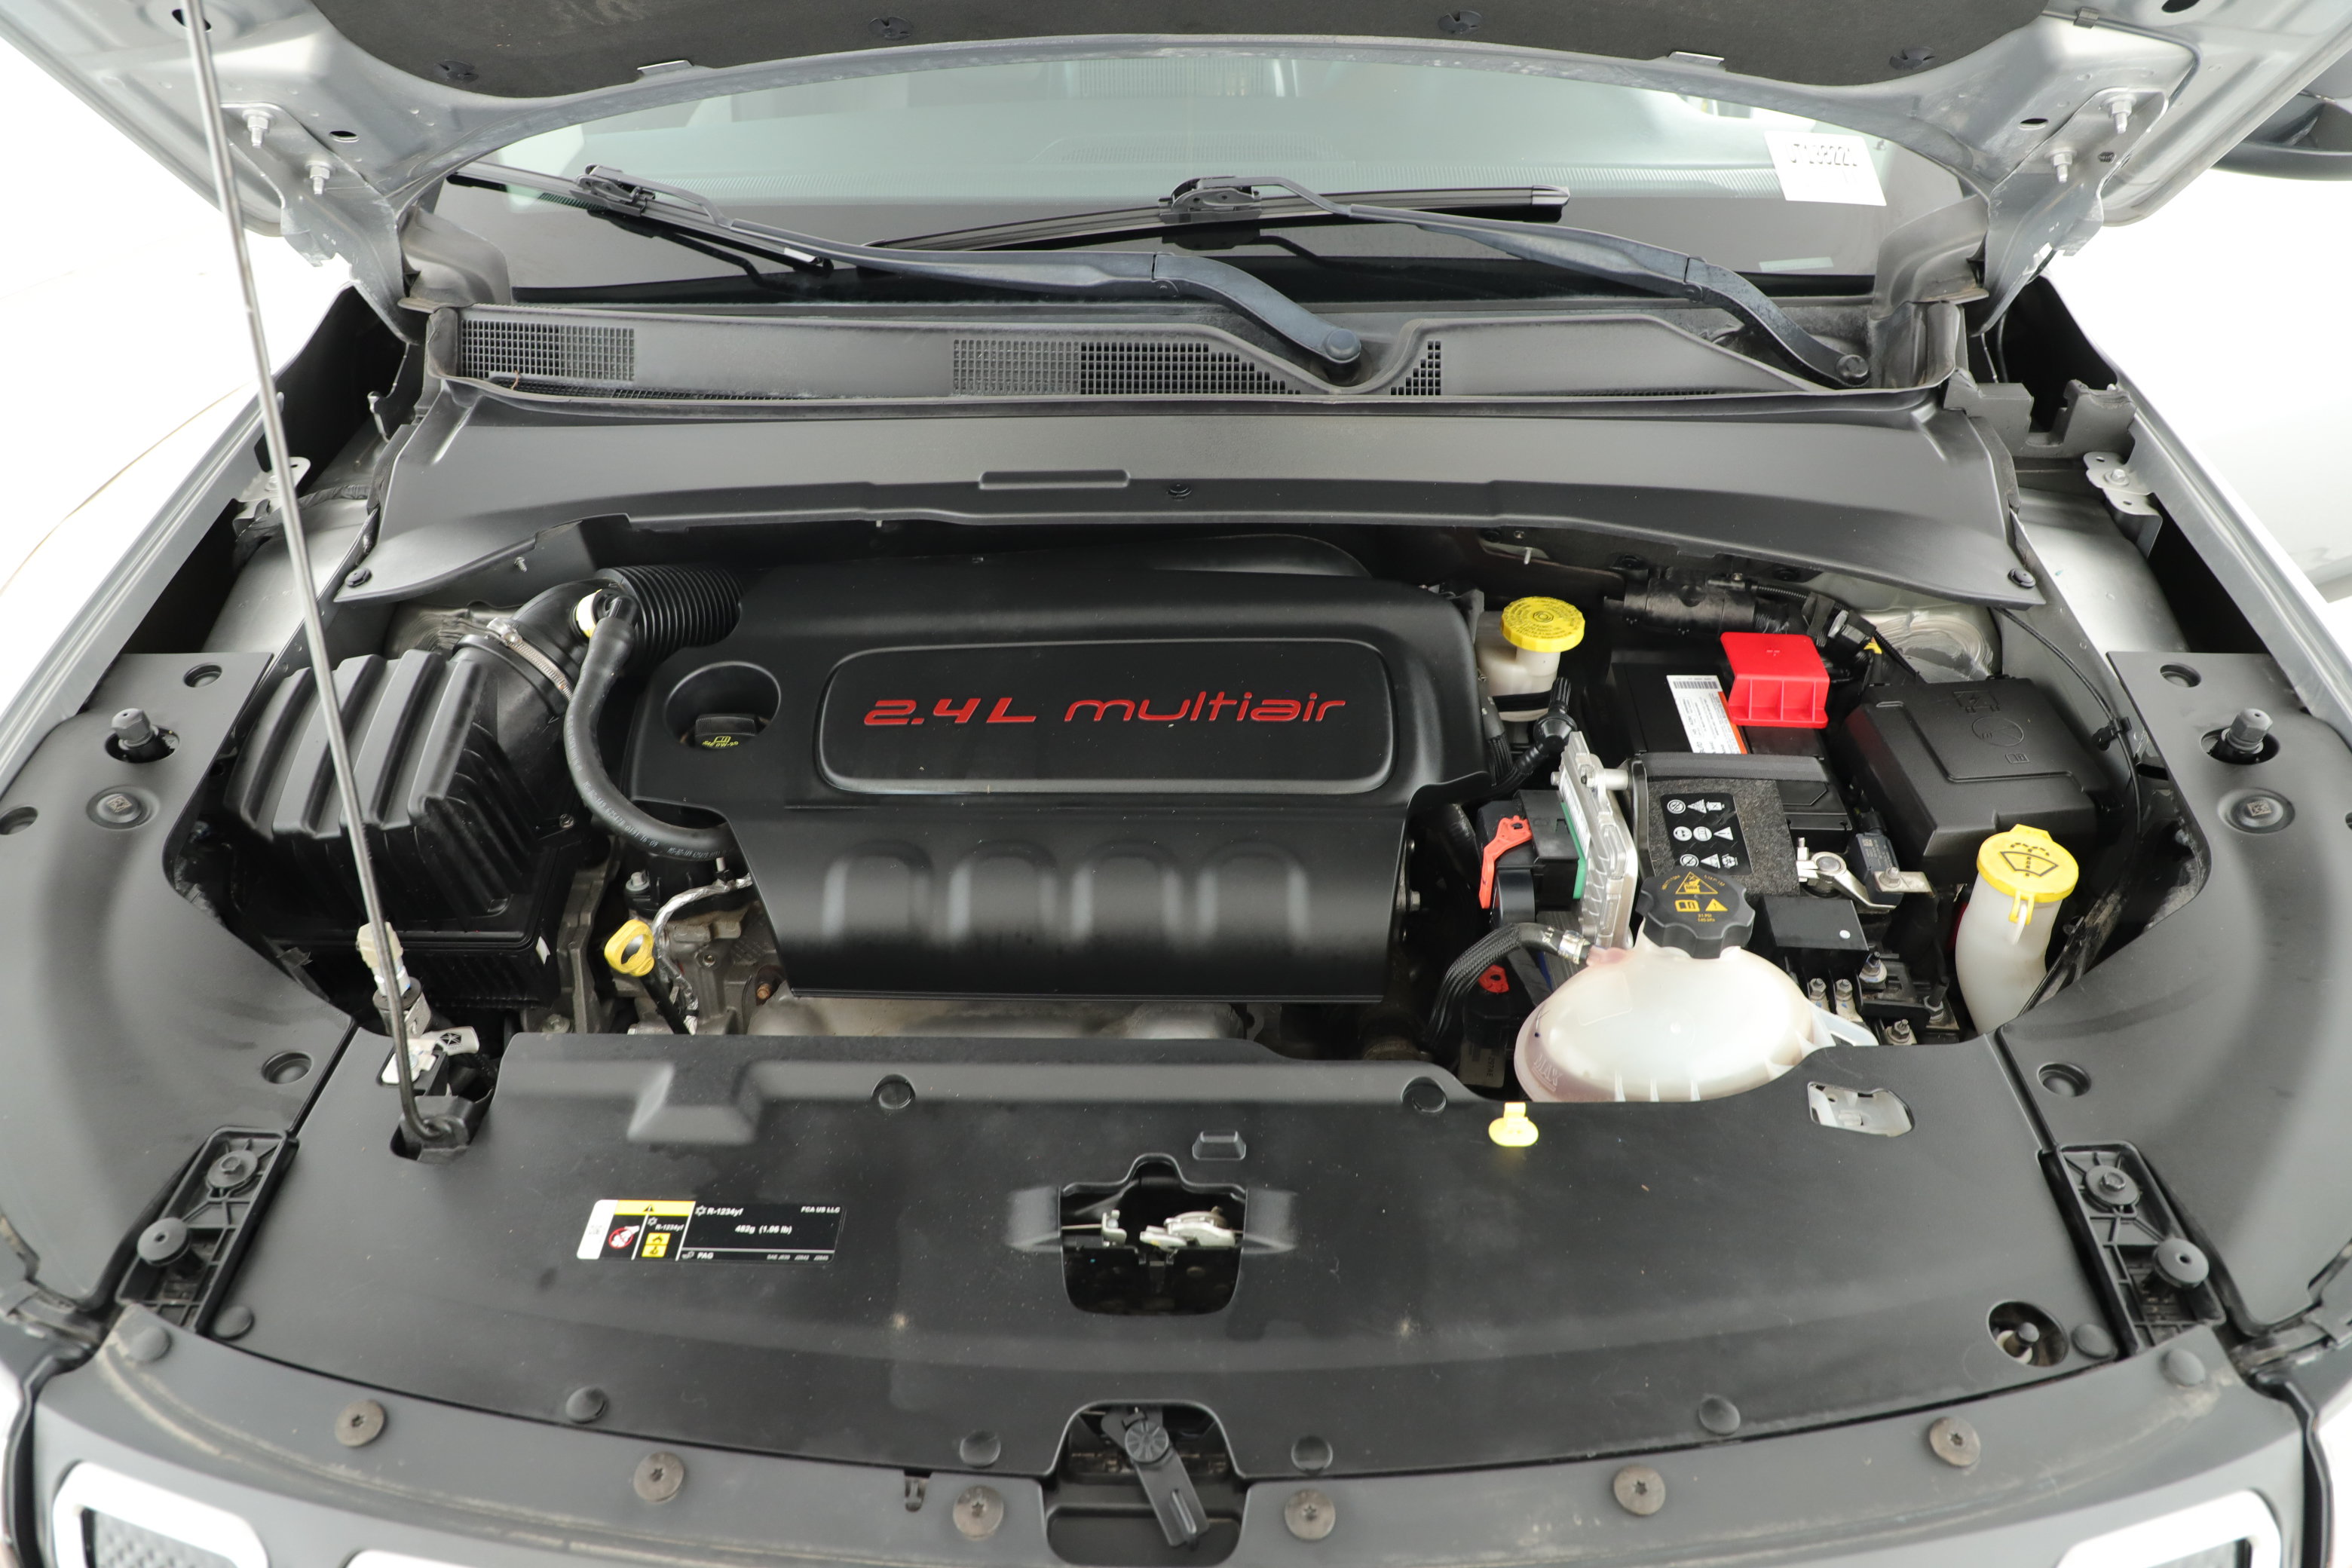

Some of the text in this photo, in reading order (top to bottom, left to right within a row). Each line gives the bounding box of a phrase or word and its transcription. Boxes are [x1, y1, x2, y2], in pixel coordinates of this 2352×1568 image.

[864, 691, 1346, 725] 2.4L multiair
[1533, 1054, 1563, 1087] MAX
[706, 1207, 744, 1217] R-1234yf
